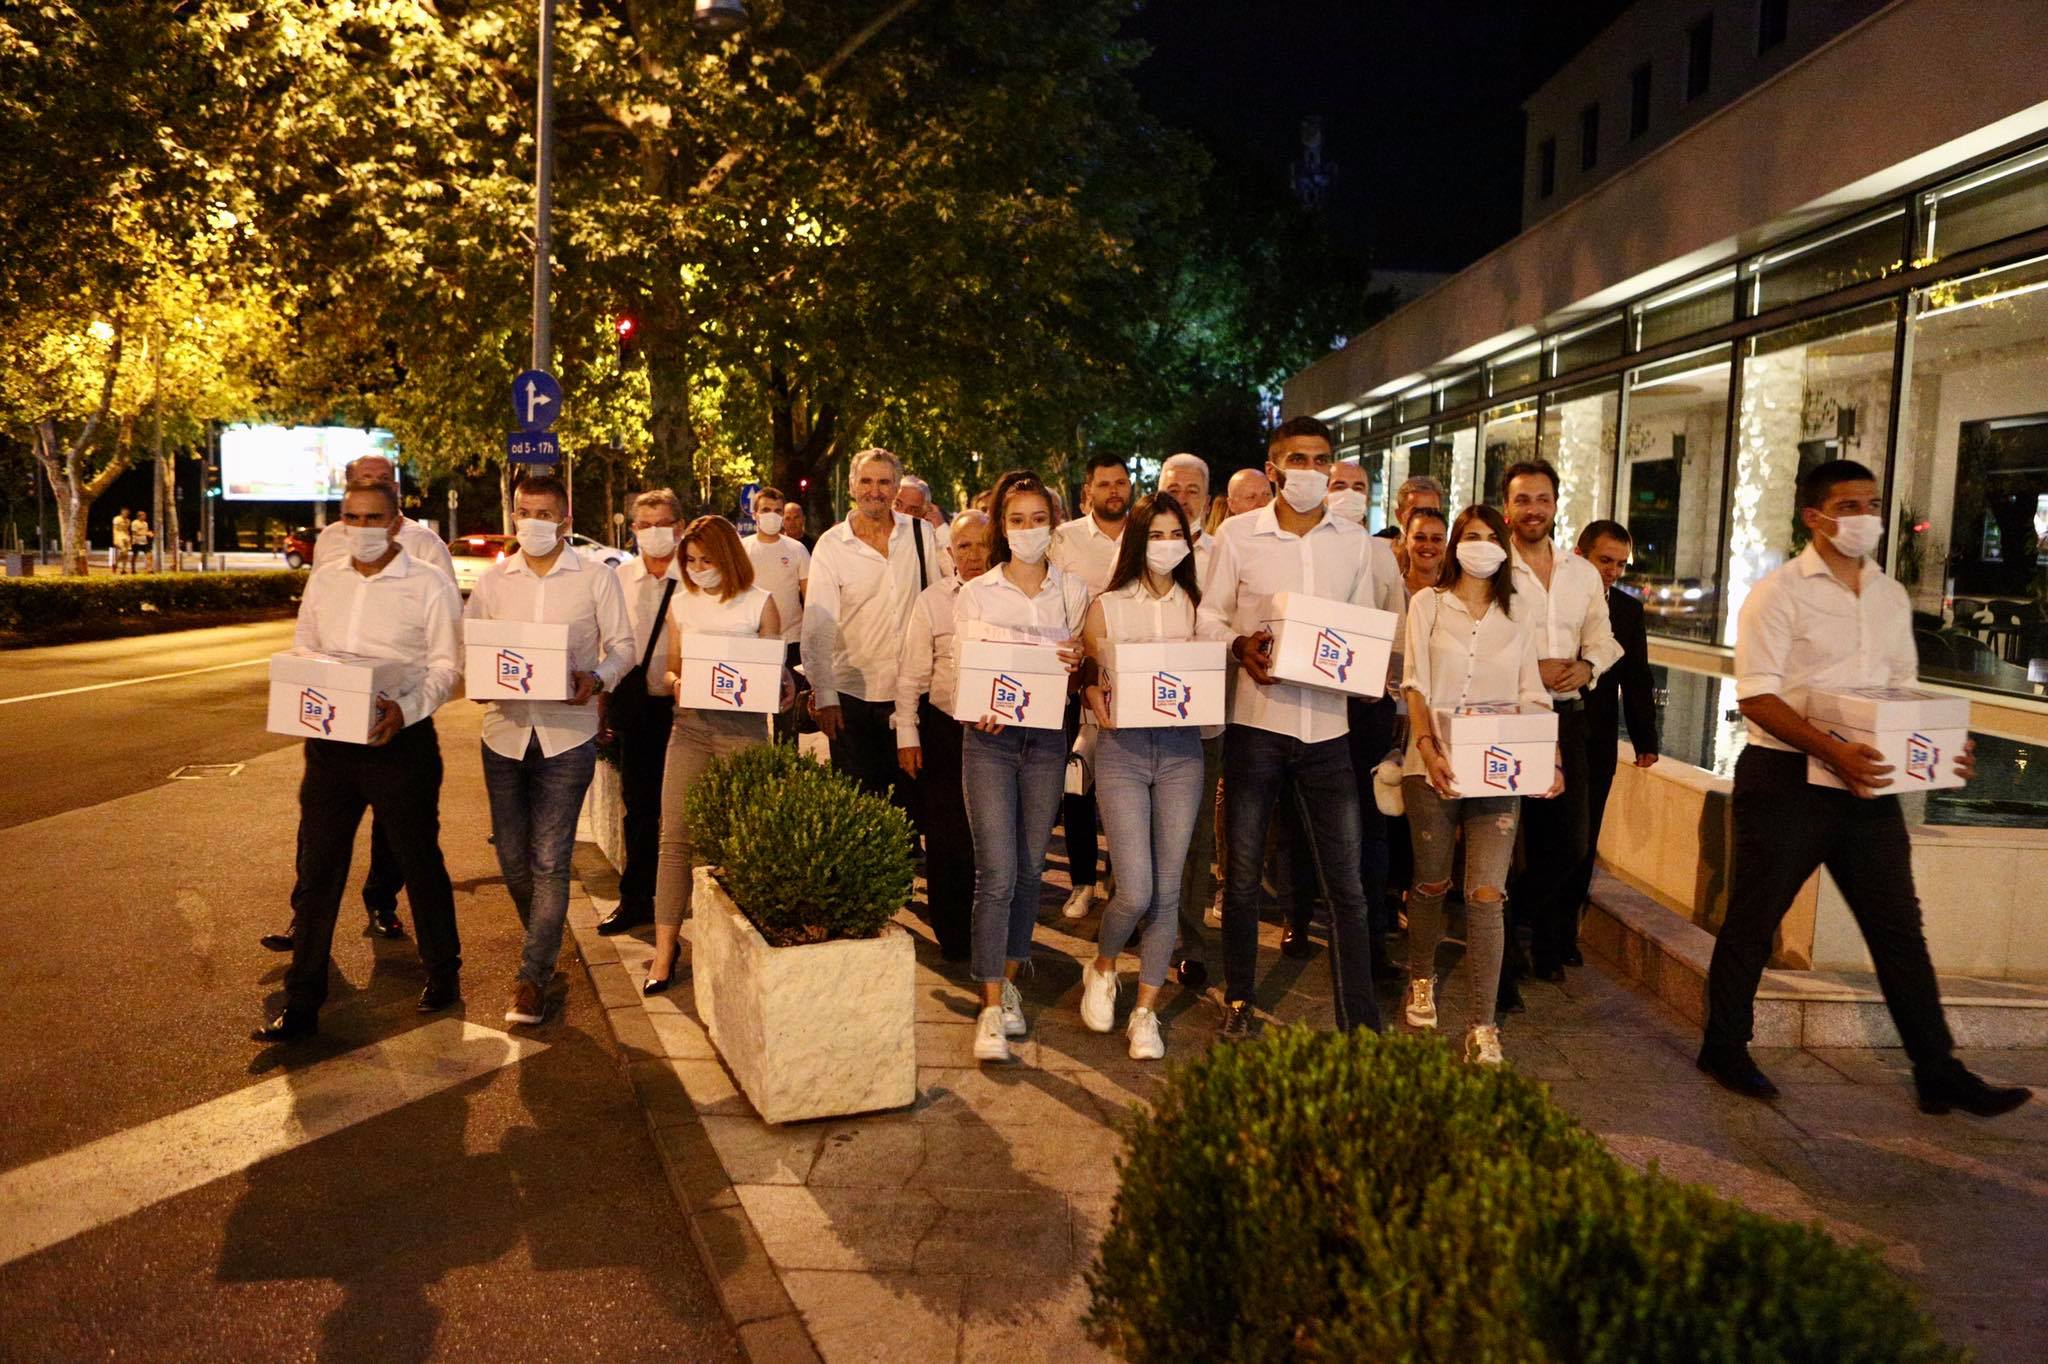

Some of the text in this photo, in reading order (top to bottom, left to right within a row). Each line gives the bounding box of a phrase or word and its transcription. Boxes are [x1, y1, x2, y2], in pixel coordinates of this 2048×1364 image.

[511, 442, 523, 454] od
[524, 442, 531, 454] 5
[538, 442, 554, 454] 17h
